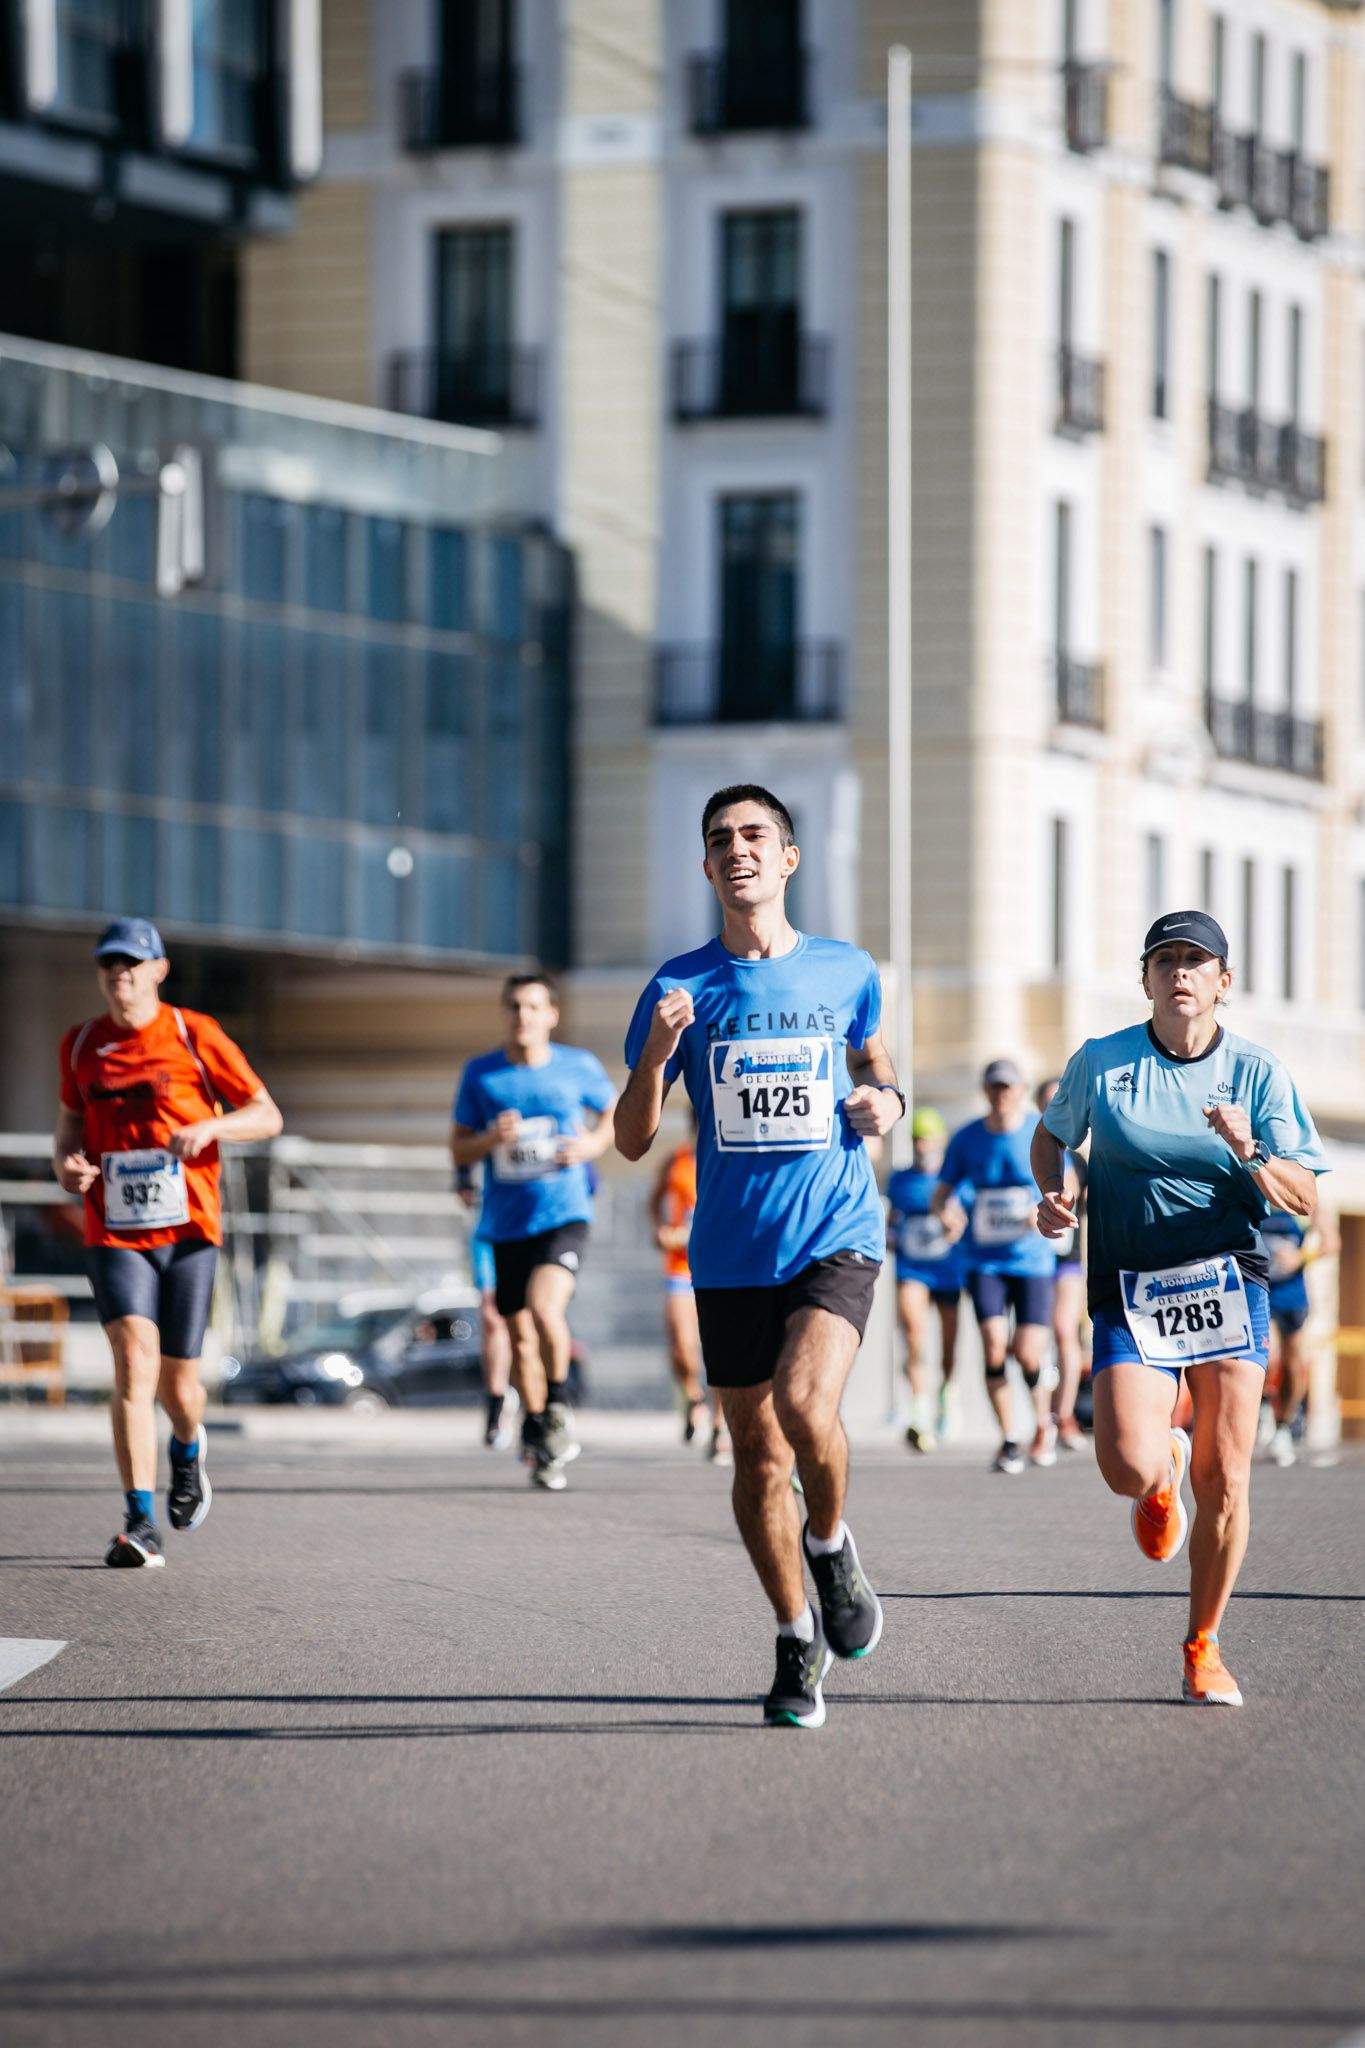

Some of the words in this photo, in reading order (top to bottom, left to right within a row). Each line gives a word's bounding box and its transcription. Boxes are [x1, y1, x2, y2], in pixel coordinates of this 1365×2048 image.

[708, 1012, 836, 1041] DECIMAS
[746, 1073, 810, 1084] DECIMAS
[1217, 1081, 1236, 1094] On
[737, 1086, 811, 1119] 1425
[1161, 1272, 1217, 1288] BOMBEROS
[1158, 1288, 1218, 1306] DECIMAS
[1151, 1299, 1224, 1337] 1283
